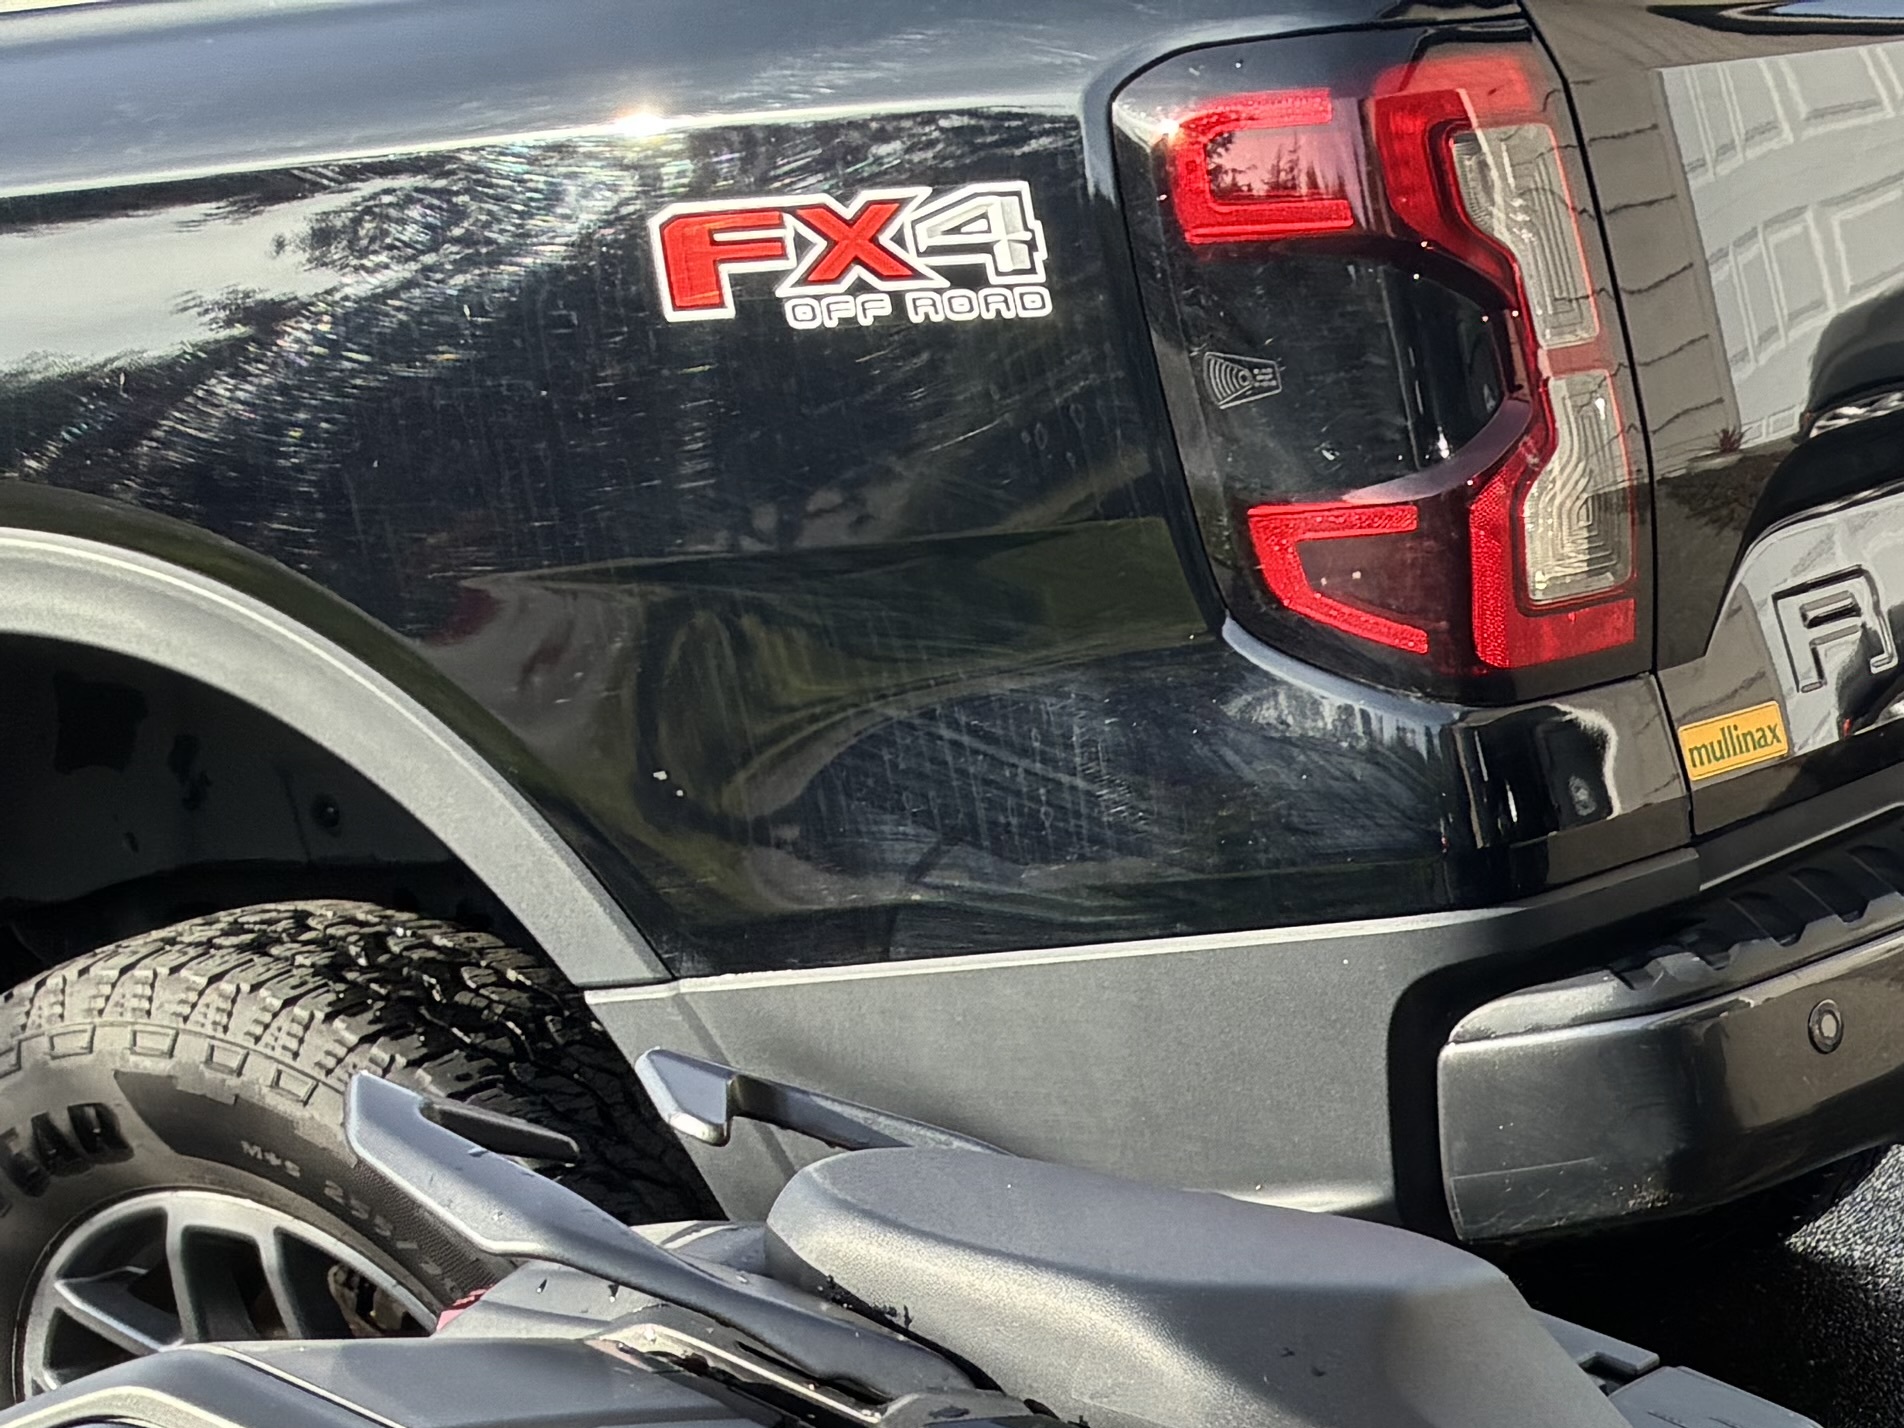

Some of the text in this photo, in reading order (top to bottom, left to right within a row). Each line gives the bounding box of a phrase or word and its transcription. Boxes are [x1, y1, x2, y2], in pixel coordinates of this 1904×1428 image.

[648, 180, 1048, 323] FX4
[784, 285, 1053, 330] OFF ROAD
[1688, 724, 1782, 768] mullinax
